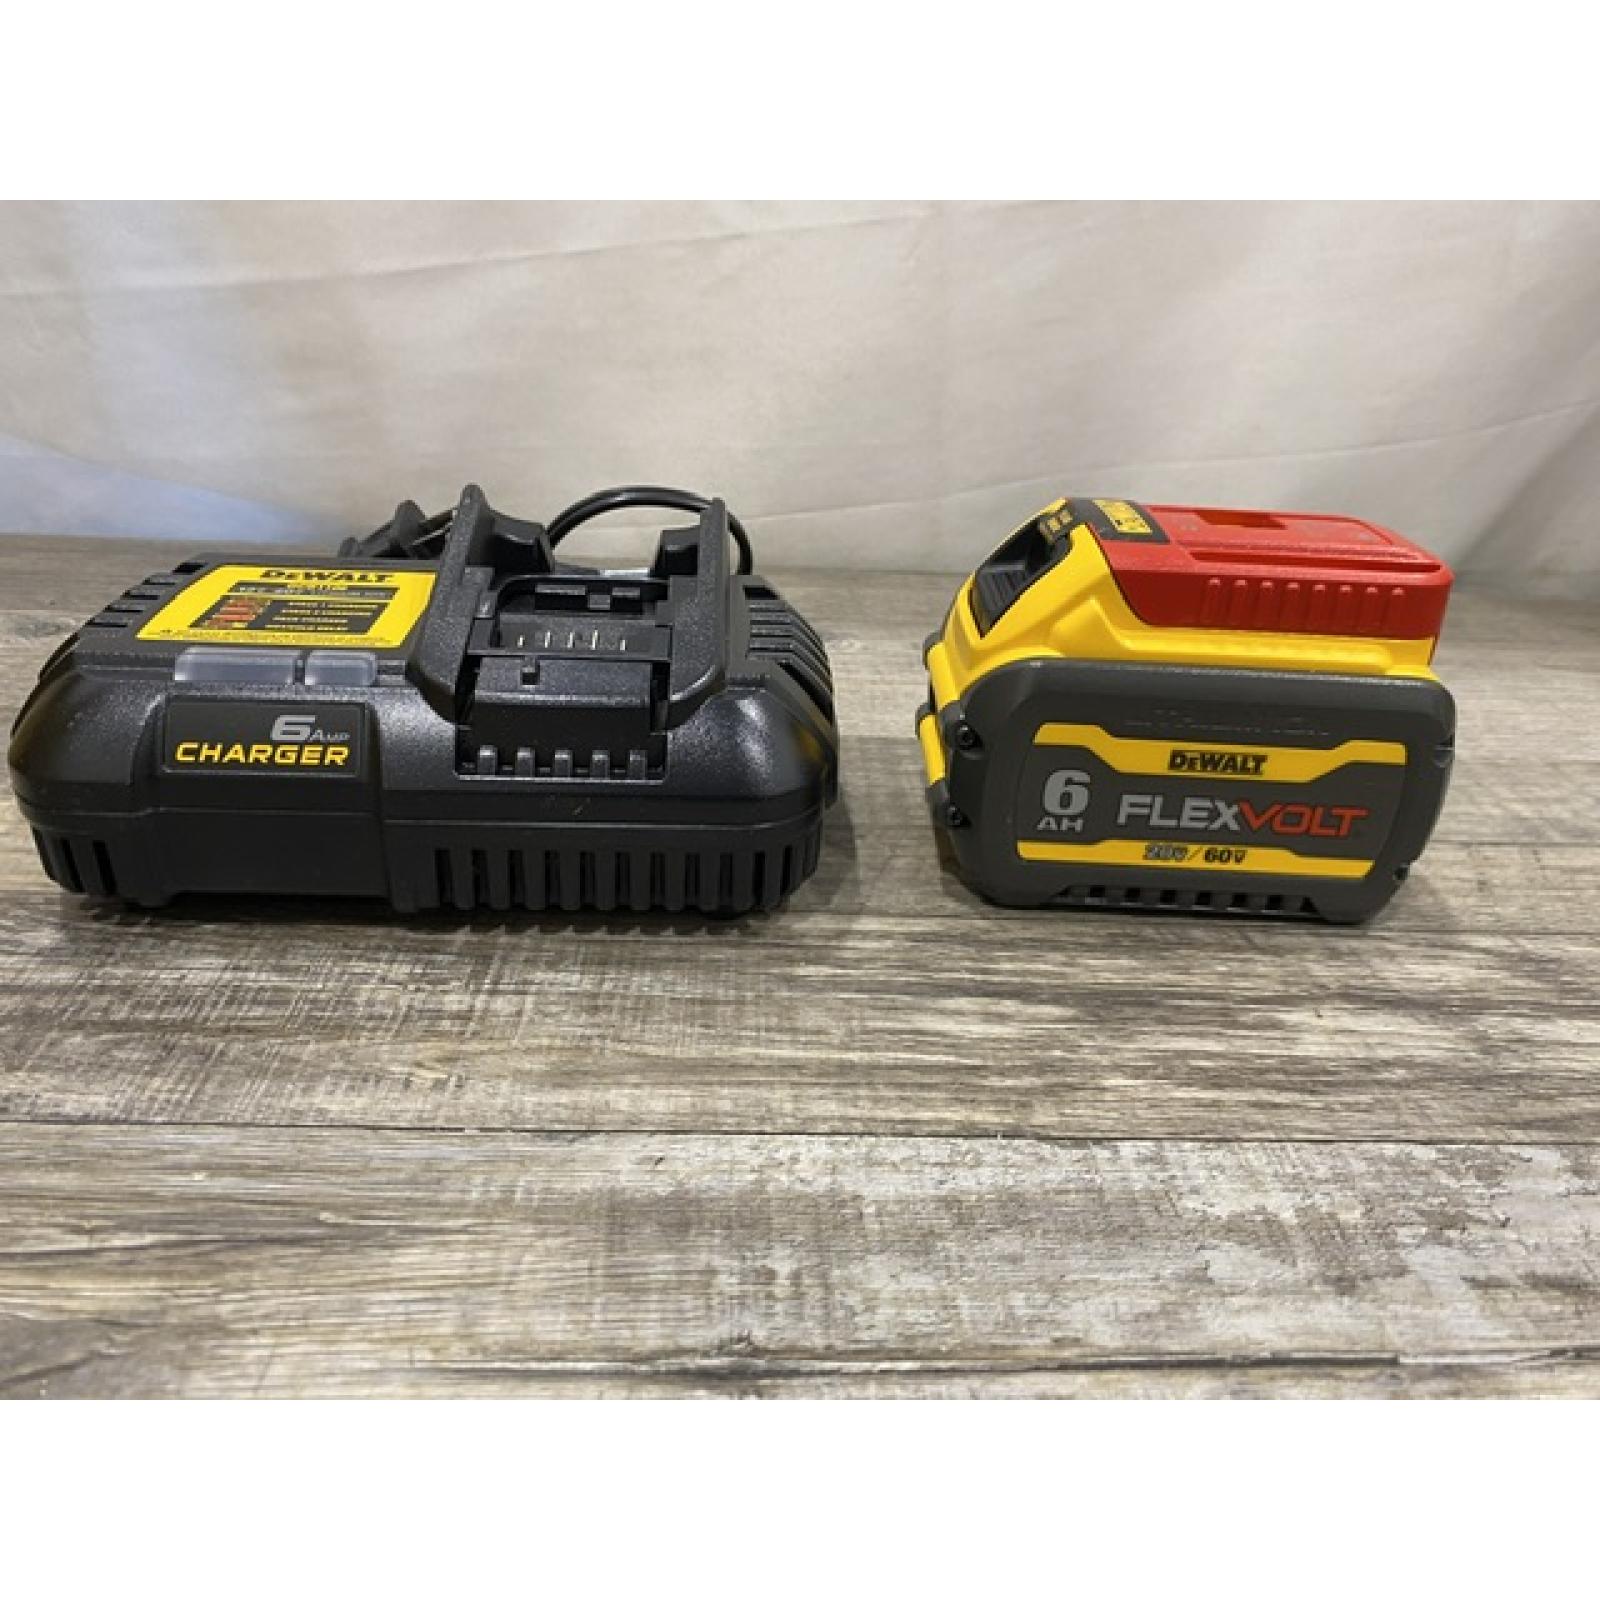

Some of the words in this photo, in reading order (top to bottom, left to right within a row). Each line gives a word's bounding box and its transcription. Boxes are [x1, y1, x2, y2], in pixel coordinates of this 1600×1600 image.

[271, 714, 316, 741] 6
[175, 742, 350, 766] CHARGER
[1042, 769, 1091, 815] 6
[1037, 816, 1084, 833] AH
[1117, 794, 1370, 838] FLEXVOLT
